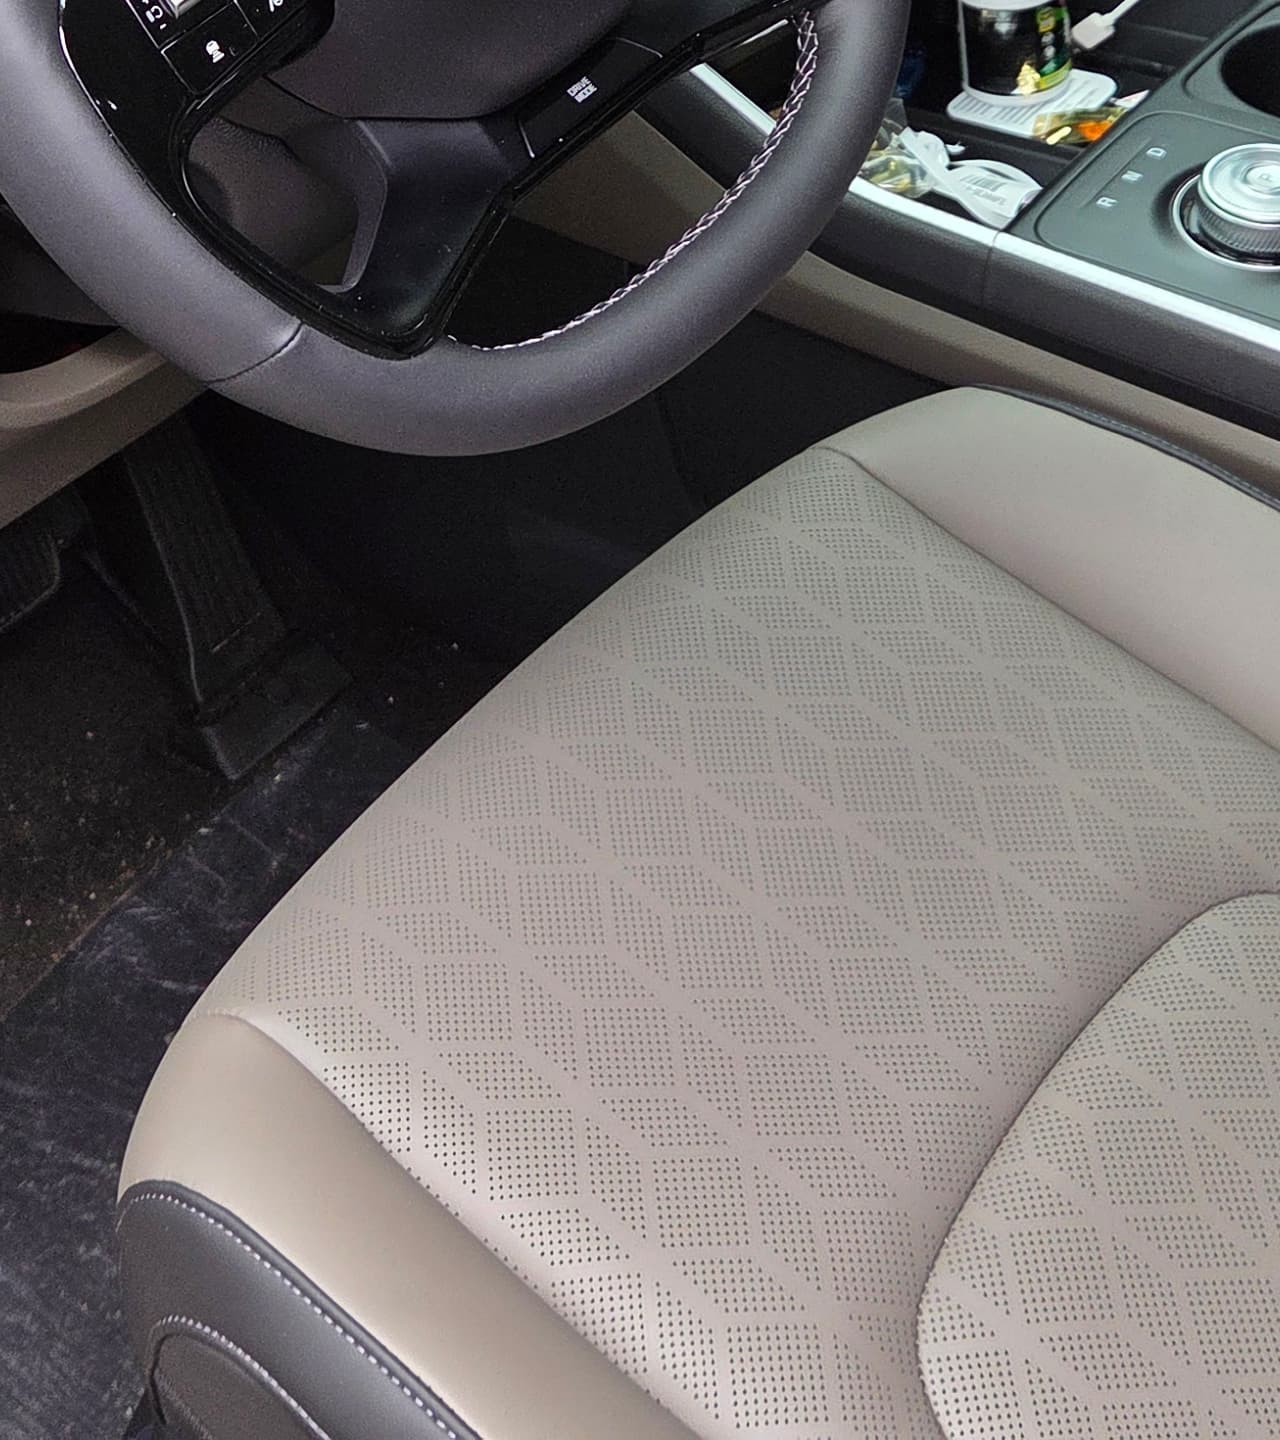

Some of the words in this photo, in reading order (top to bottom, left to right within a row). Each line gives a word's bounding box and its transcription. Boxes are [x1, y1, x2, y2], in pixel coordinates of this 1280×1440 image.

[566, 75, 592, 97] DRIVE
[1145, 147, 1168, 160] D
[1120, 170, 1144, 182] N
[1095, 196, 1118, 208] R
